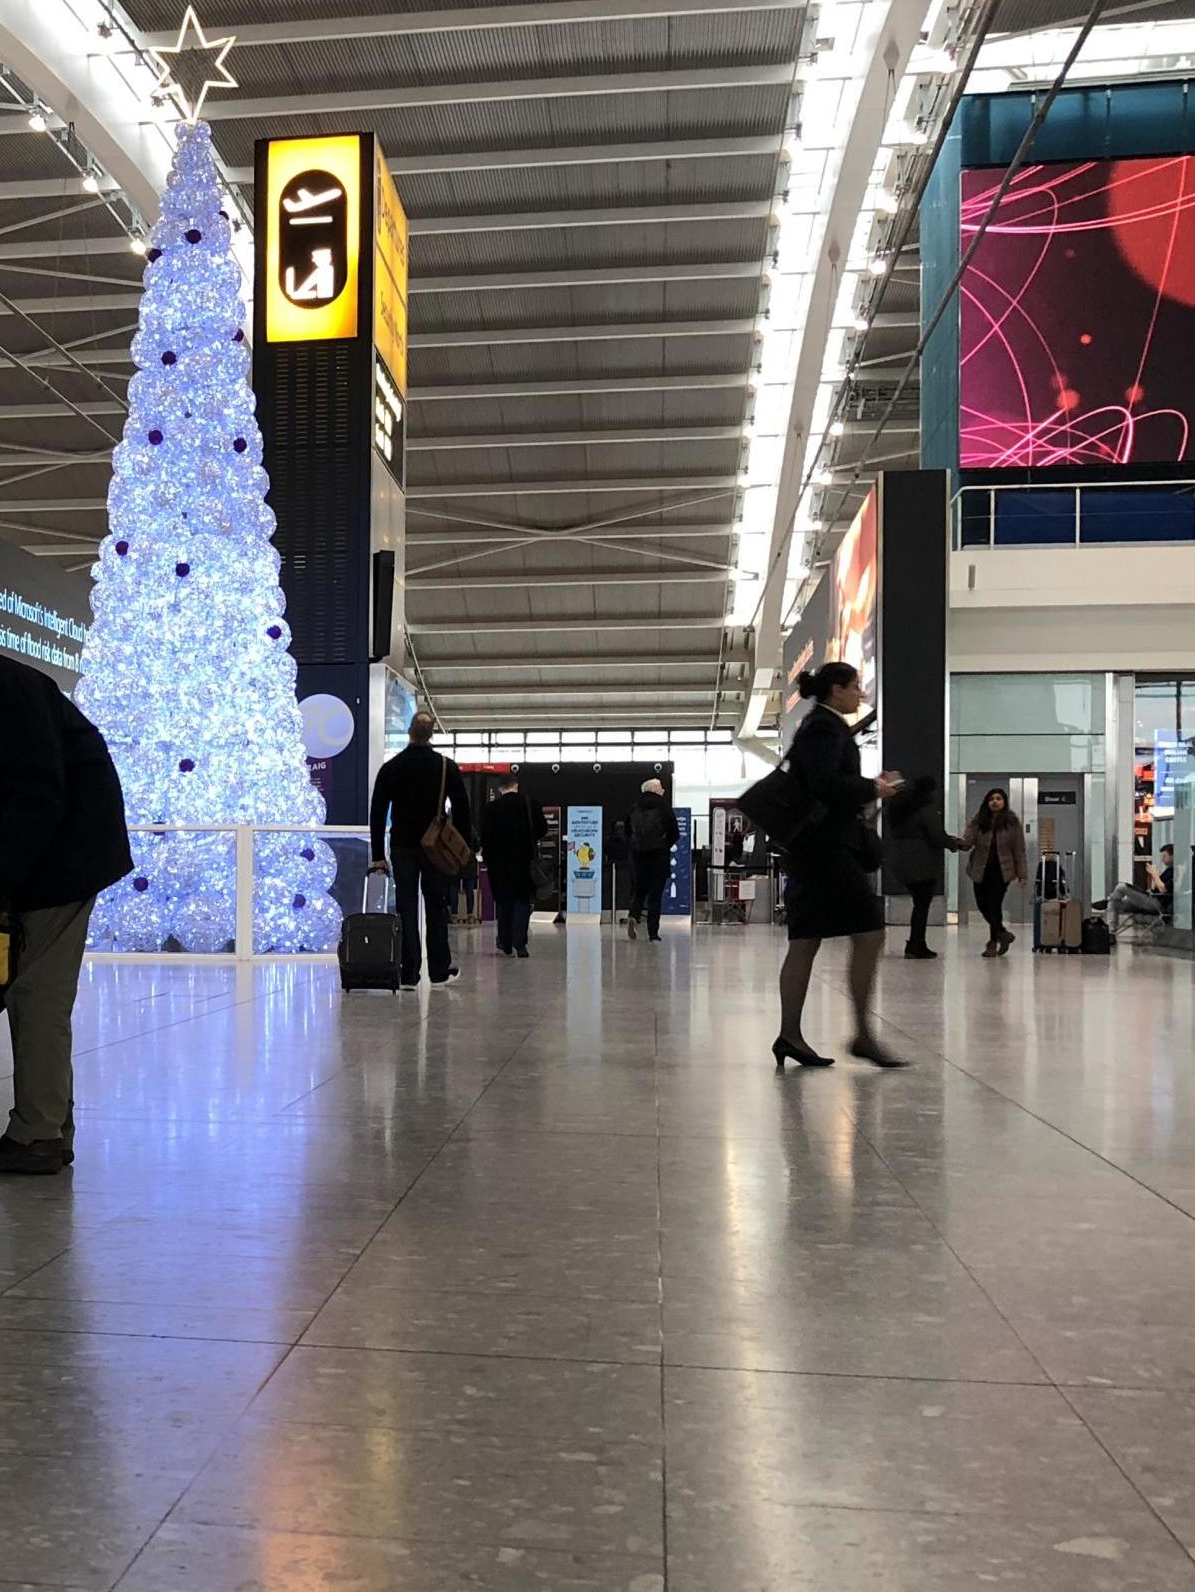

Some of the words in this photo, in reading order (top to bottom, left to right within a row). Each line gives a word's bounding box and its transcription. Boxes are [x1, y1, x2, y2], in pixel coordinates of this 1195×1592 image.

[7, 591, 15, 614] of
[43, 607, 68, 639] Intelligent
[68, 617, 84, 642] Cloud
[6, 626, 20, 652] time
[20, 631, 28, 654] of
[27, 632, 42, 660] flood
[41, 637, 51, 662] risk
[51, 643, 63, 667] data
[62, 646, 75, 671] from
